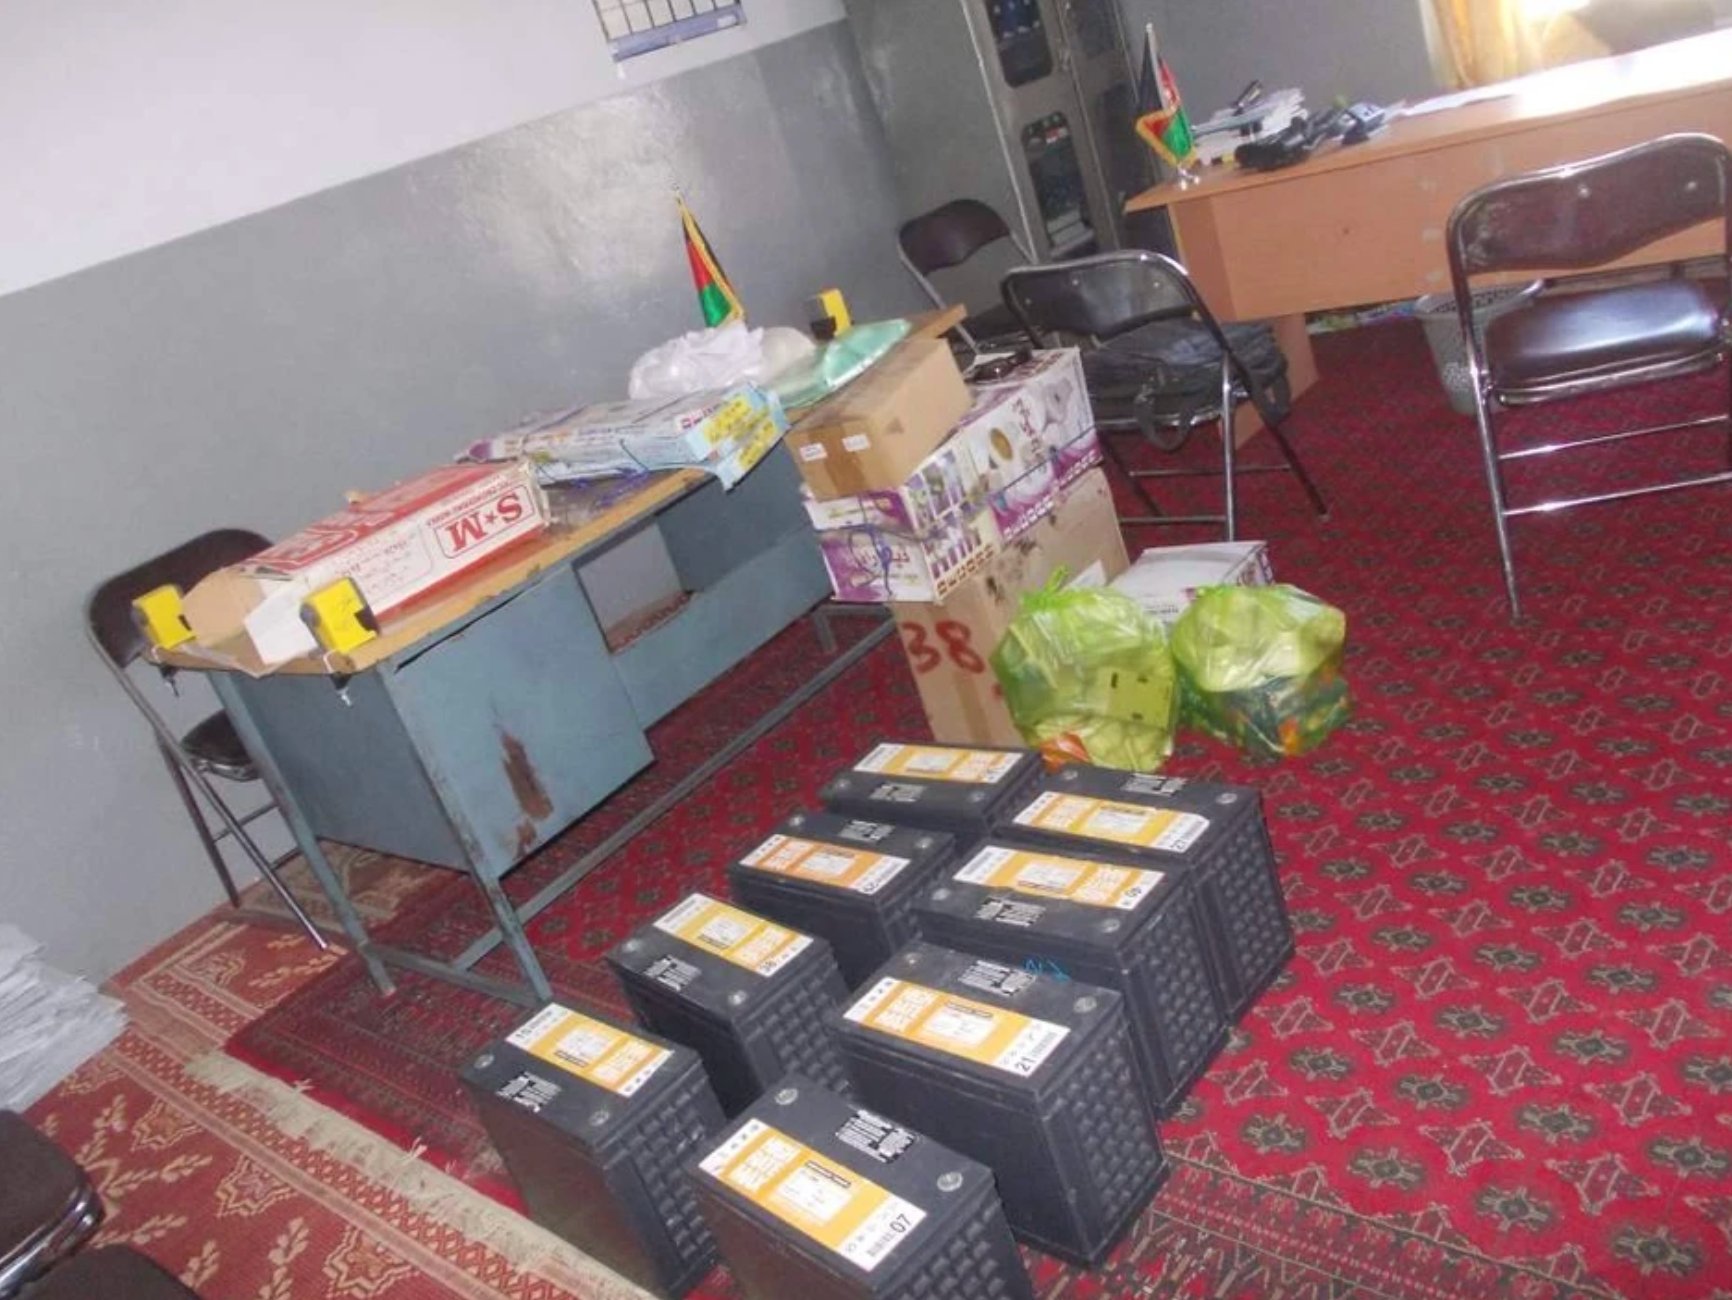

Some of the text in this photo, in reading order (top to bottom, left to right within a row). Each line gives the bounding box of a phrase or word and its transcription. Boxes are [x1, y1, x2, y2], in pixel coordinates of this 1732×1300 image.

[901, 620, 985, 675] 38
[1014, 1056, 1036, 1072] 21
[889, 1213, 911, 1233] 07
